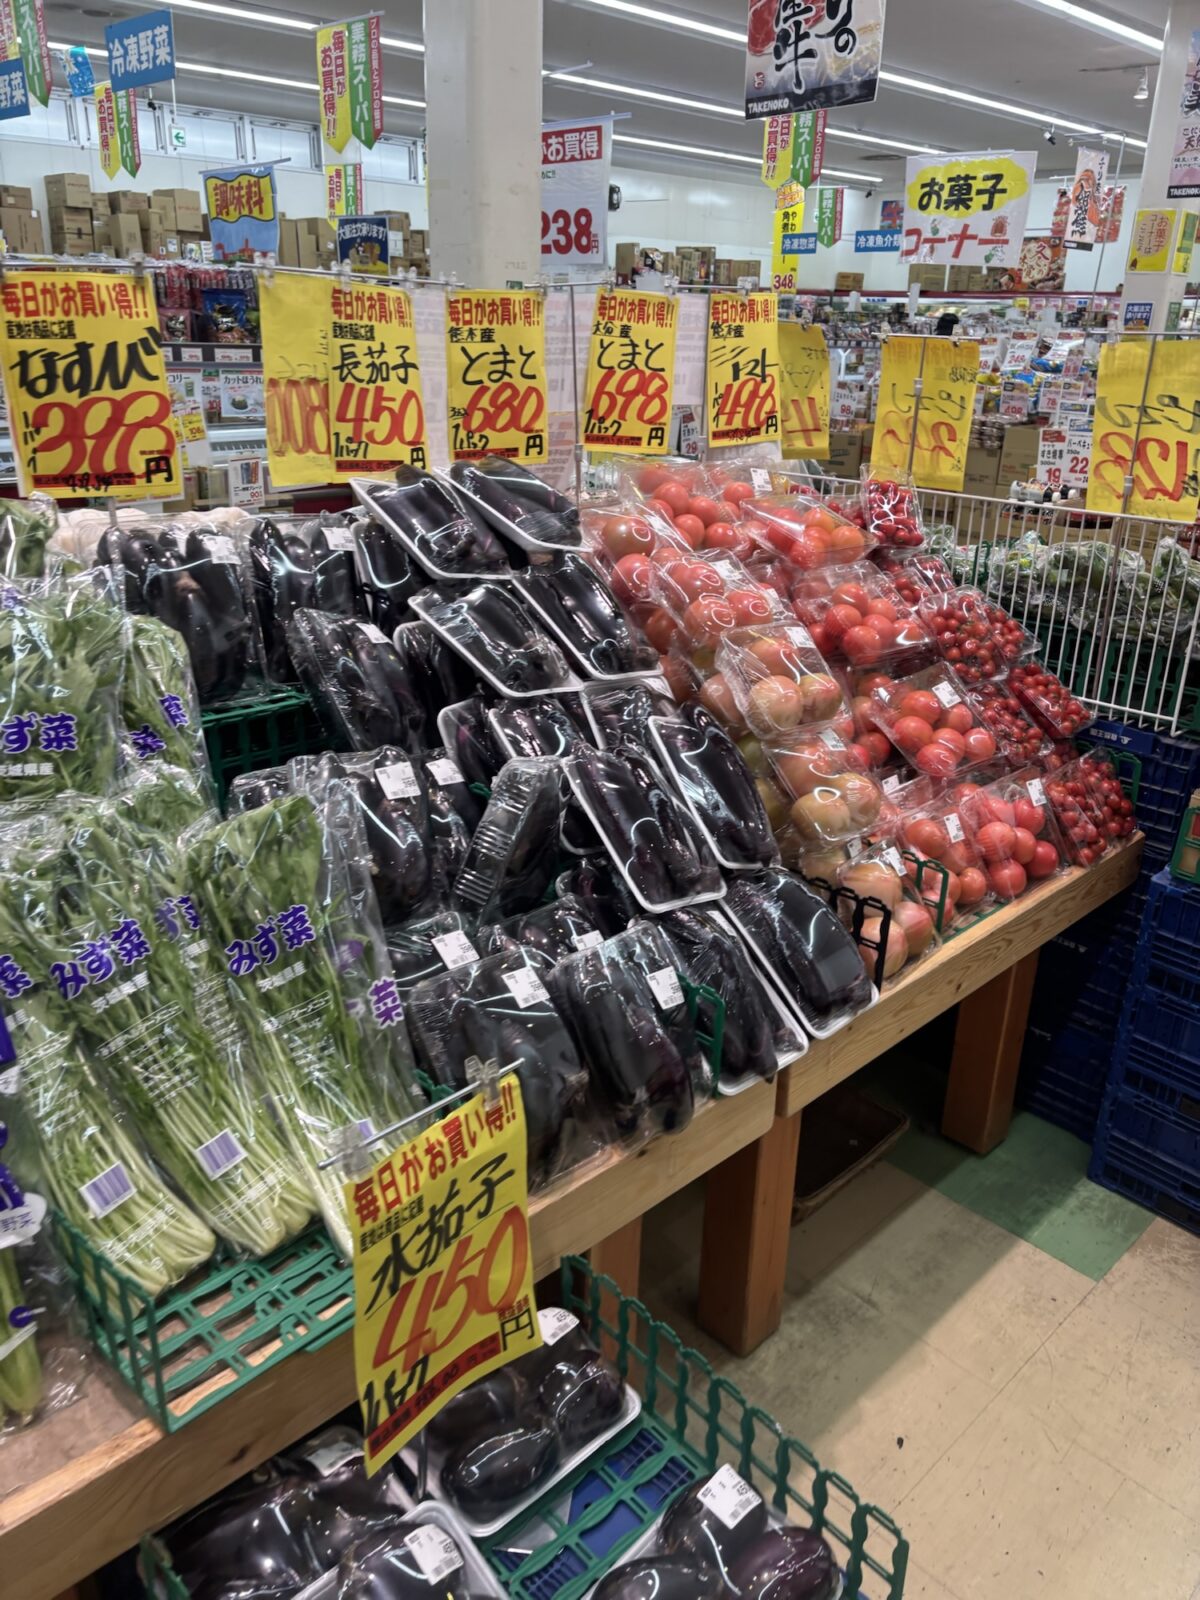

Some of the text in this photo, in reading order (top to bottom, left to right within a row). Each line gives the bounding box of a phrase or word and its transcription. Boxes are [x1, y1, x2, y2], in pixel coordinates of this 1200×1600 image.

[110, 25, 171, 77] 冷凍野菜
[331, 28, 346, 98] 毎日が
[351, 21, 369, 141] 業務スーパー
[747, 98, 790, 114] TAKENOKO
[213, 178, 265, 217] 調味料
[917, 173, 1008, 211] お菓子
[901, 223, 1009, 259] コーナー
[1, 281, 150, 319] 毎日がお買い得!!
[773, 274, 794, 290] 348
[331, 287, 413, 328] 毎日がお買い得!!
[448, 297, 540, 327] 毎日がお買い得!!
[598, 294, 675, 328] 毎日がお買い得!!
[712, 298, 776, 324] 毎日がお買い得!!
[332, 342, 419, 384] 長茄子
[460, 344, 537, 386] とまと
[597, 338, 666, 372] とまと
[166, 374, 191, 384] コリー
[223, 374, 264, 385] カットほうれ
[462, 381, 545, 433] 680
[525, 434, 544, 456] 円
[590, 368, 669, 425] 698
[647, 426, 665, 446] 円
[718, 373, 778, 434] 498 円
[32, 390, 176, 484] 398 円
[336, 382, 425, 448] 450
[410, 447, 427, 470] 円
[1046, 467, 1062, 483] 19
[1069, 456, 1089, 474] 22
[1, 712, 78, 754] ず菜
[51, 919, 152, 1001] みず菜
[225, 904, 316, 977] みず菜
[353, 1082, 517, 1228] 毎日がお買い得!!
[364, 1152, 516, 1316] 水茄子
[372, 1204, 535, 1375] 450 円
